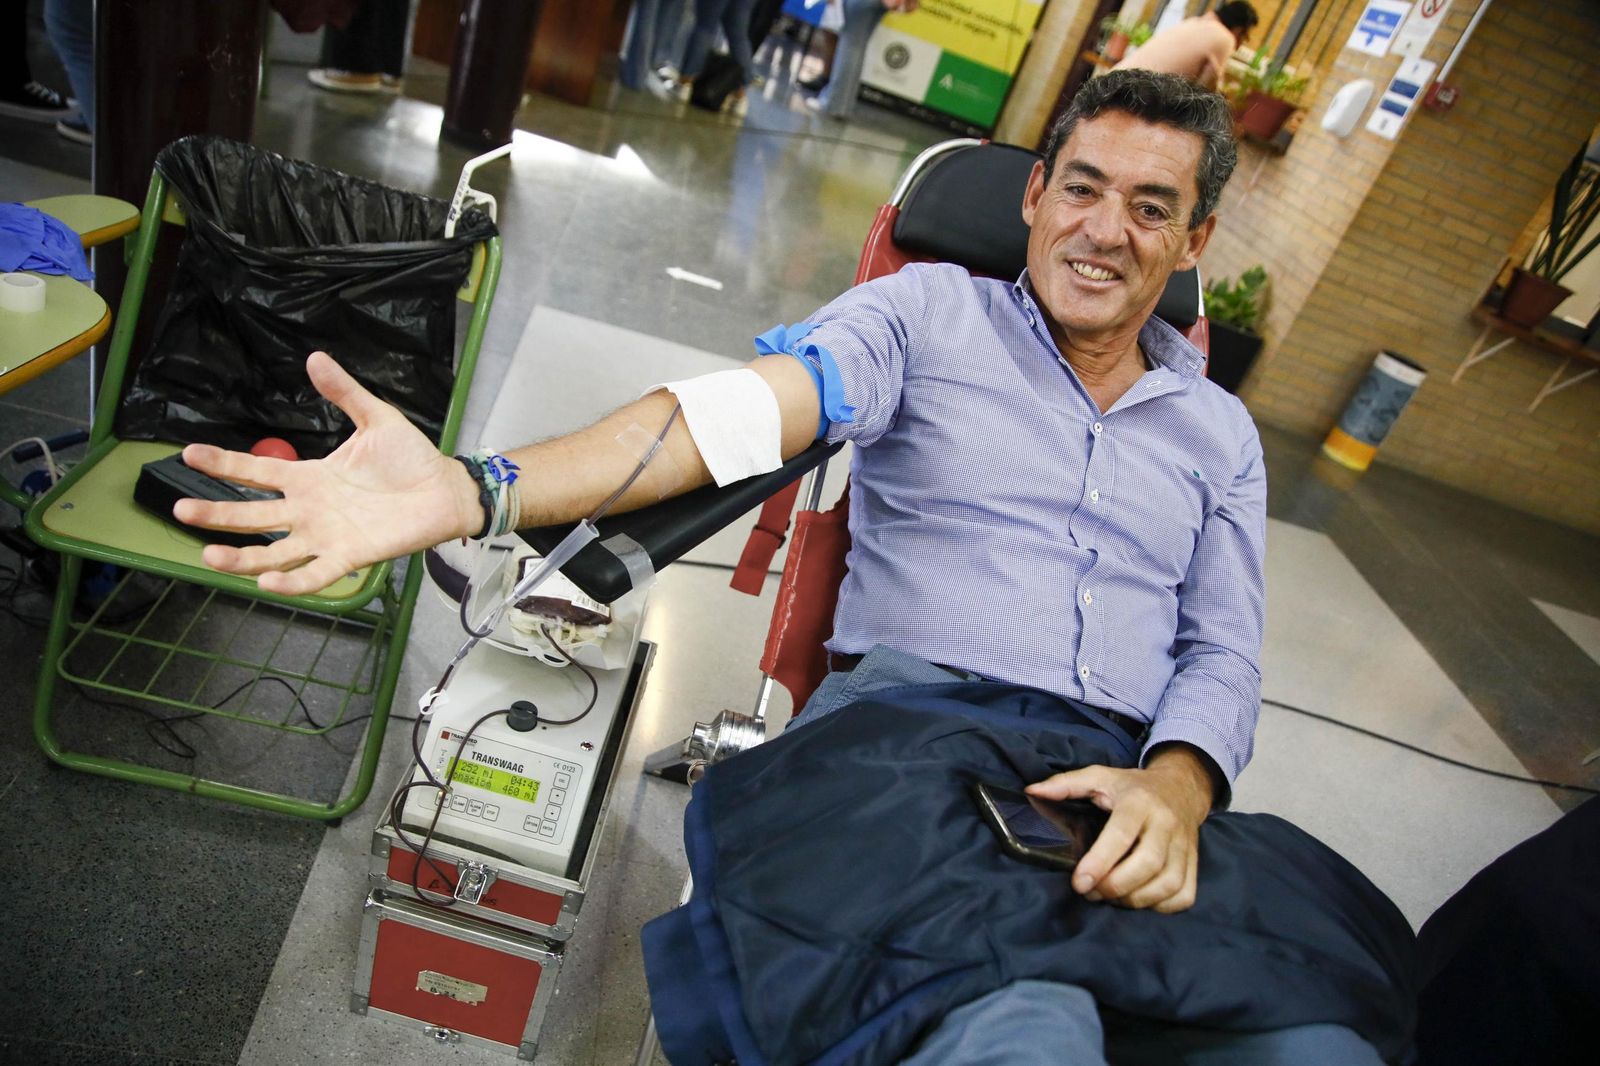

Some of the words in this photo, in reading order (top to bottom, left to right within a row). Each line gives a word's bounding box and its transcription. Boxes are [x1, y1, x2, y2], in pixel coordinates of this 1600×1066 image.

[471, 751, 524, 773] TRANSWAAG
[562, 764, 576, 773] 0123
[451, 771, 492, 789] onacion
[502, 785, 520, 796] 460
[460, 762, 479, 775] 252
[511, 775, 540, 792] 04:43
